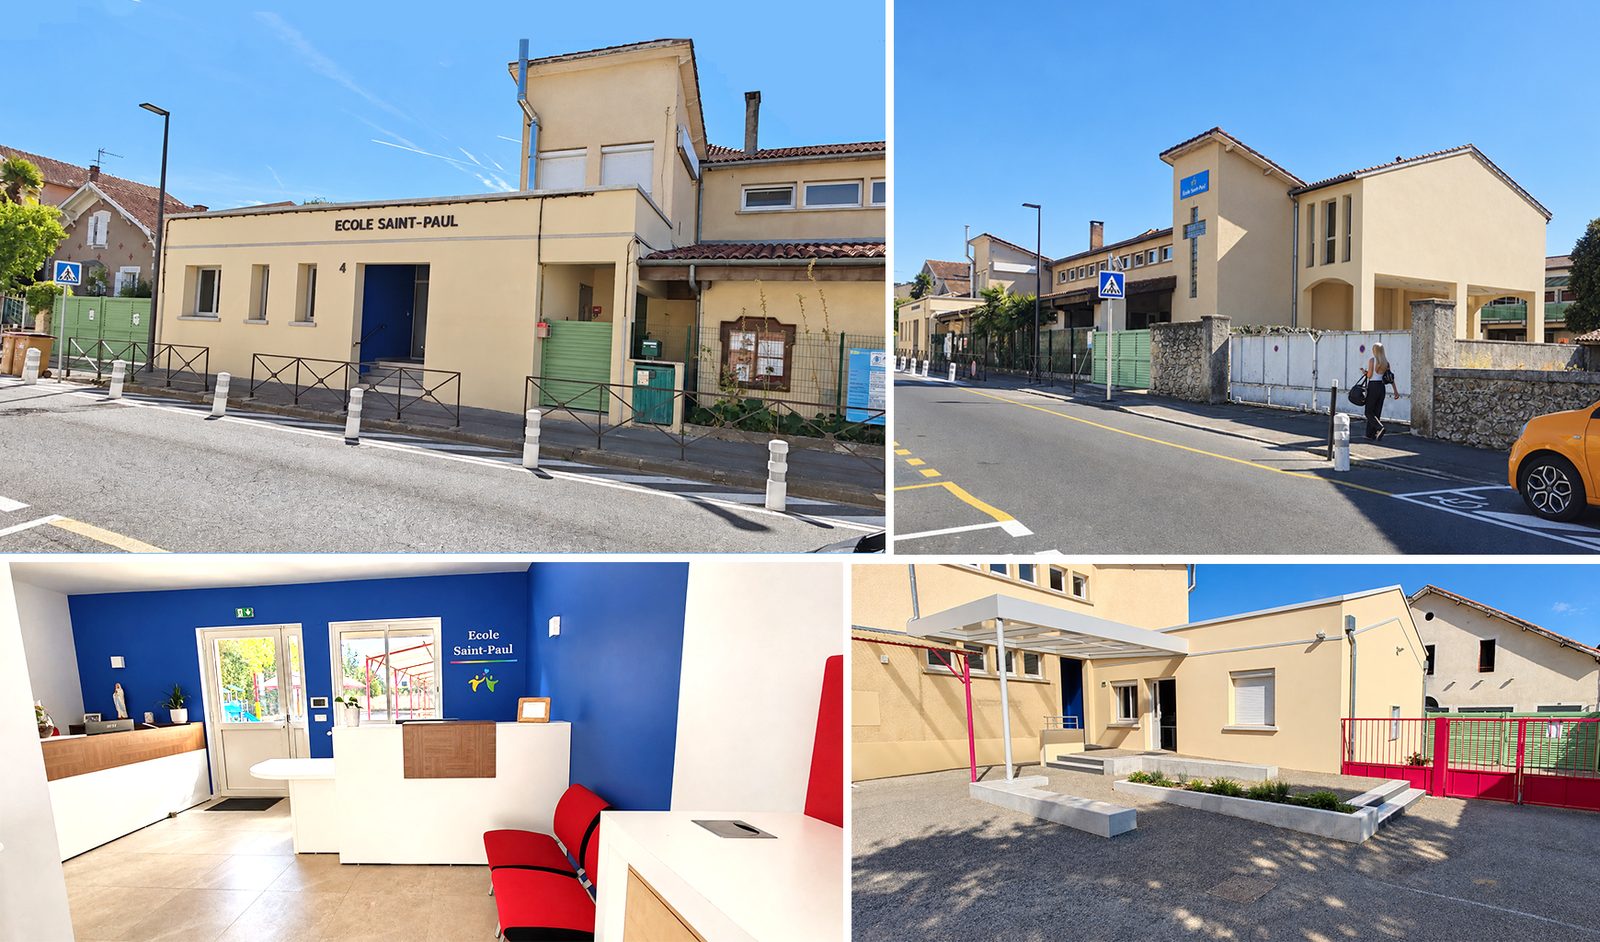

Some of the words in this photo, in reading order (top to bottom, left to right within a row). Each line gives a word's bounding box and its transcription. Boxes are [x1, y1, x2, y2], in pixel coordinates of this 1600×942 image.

[335, 218, 374, 231] ECOLE
[377, 215, 459, 230] SAINT-PAUL
[339, 262, 347, 273] 4
[468, 629, 500, 640] Ecole
[453, 643, 513, 656] Saint-Paul
